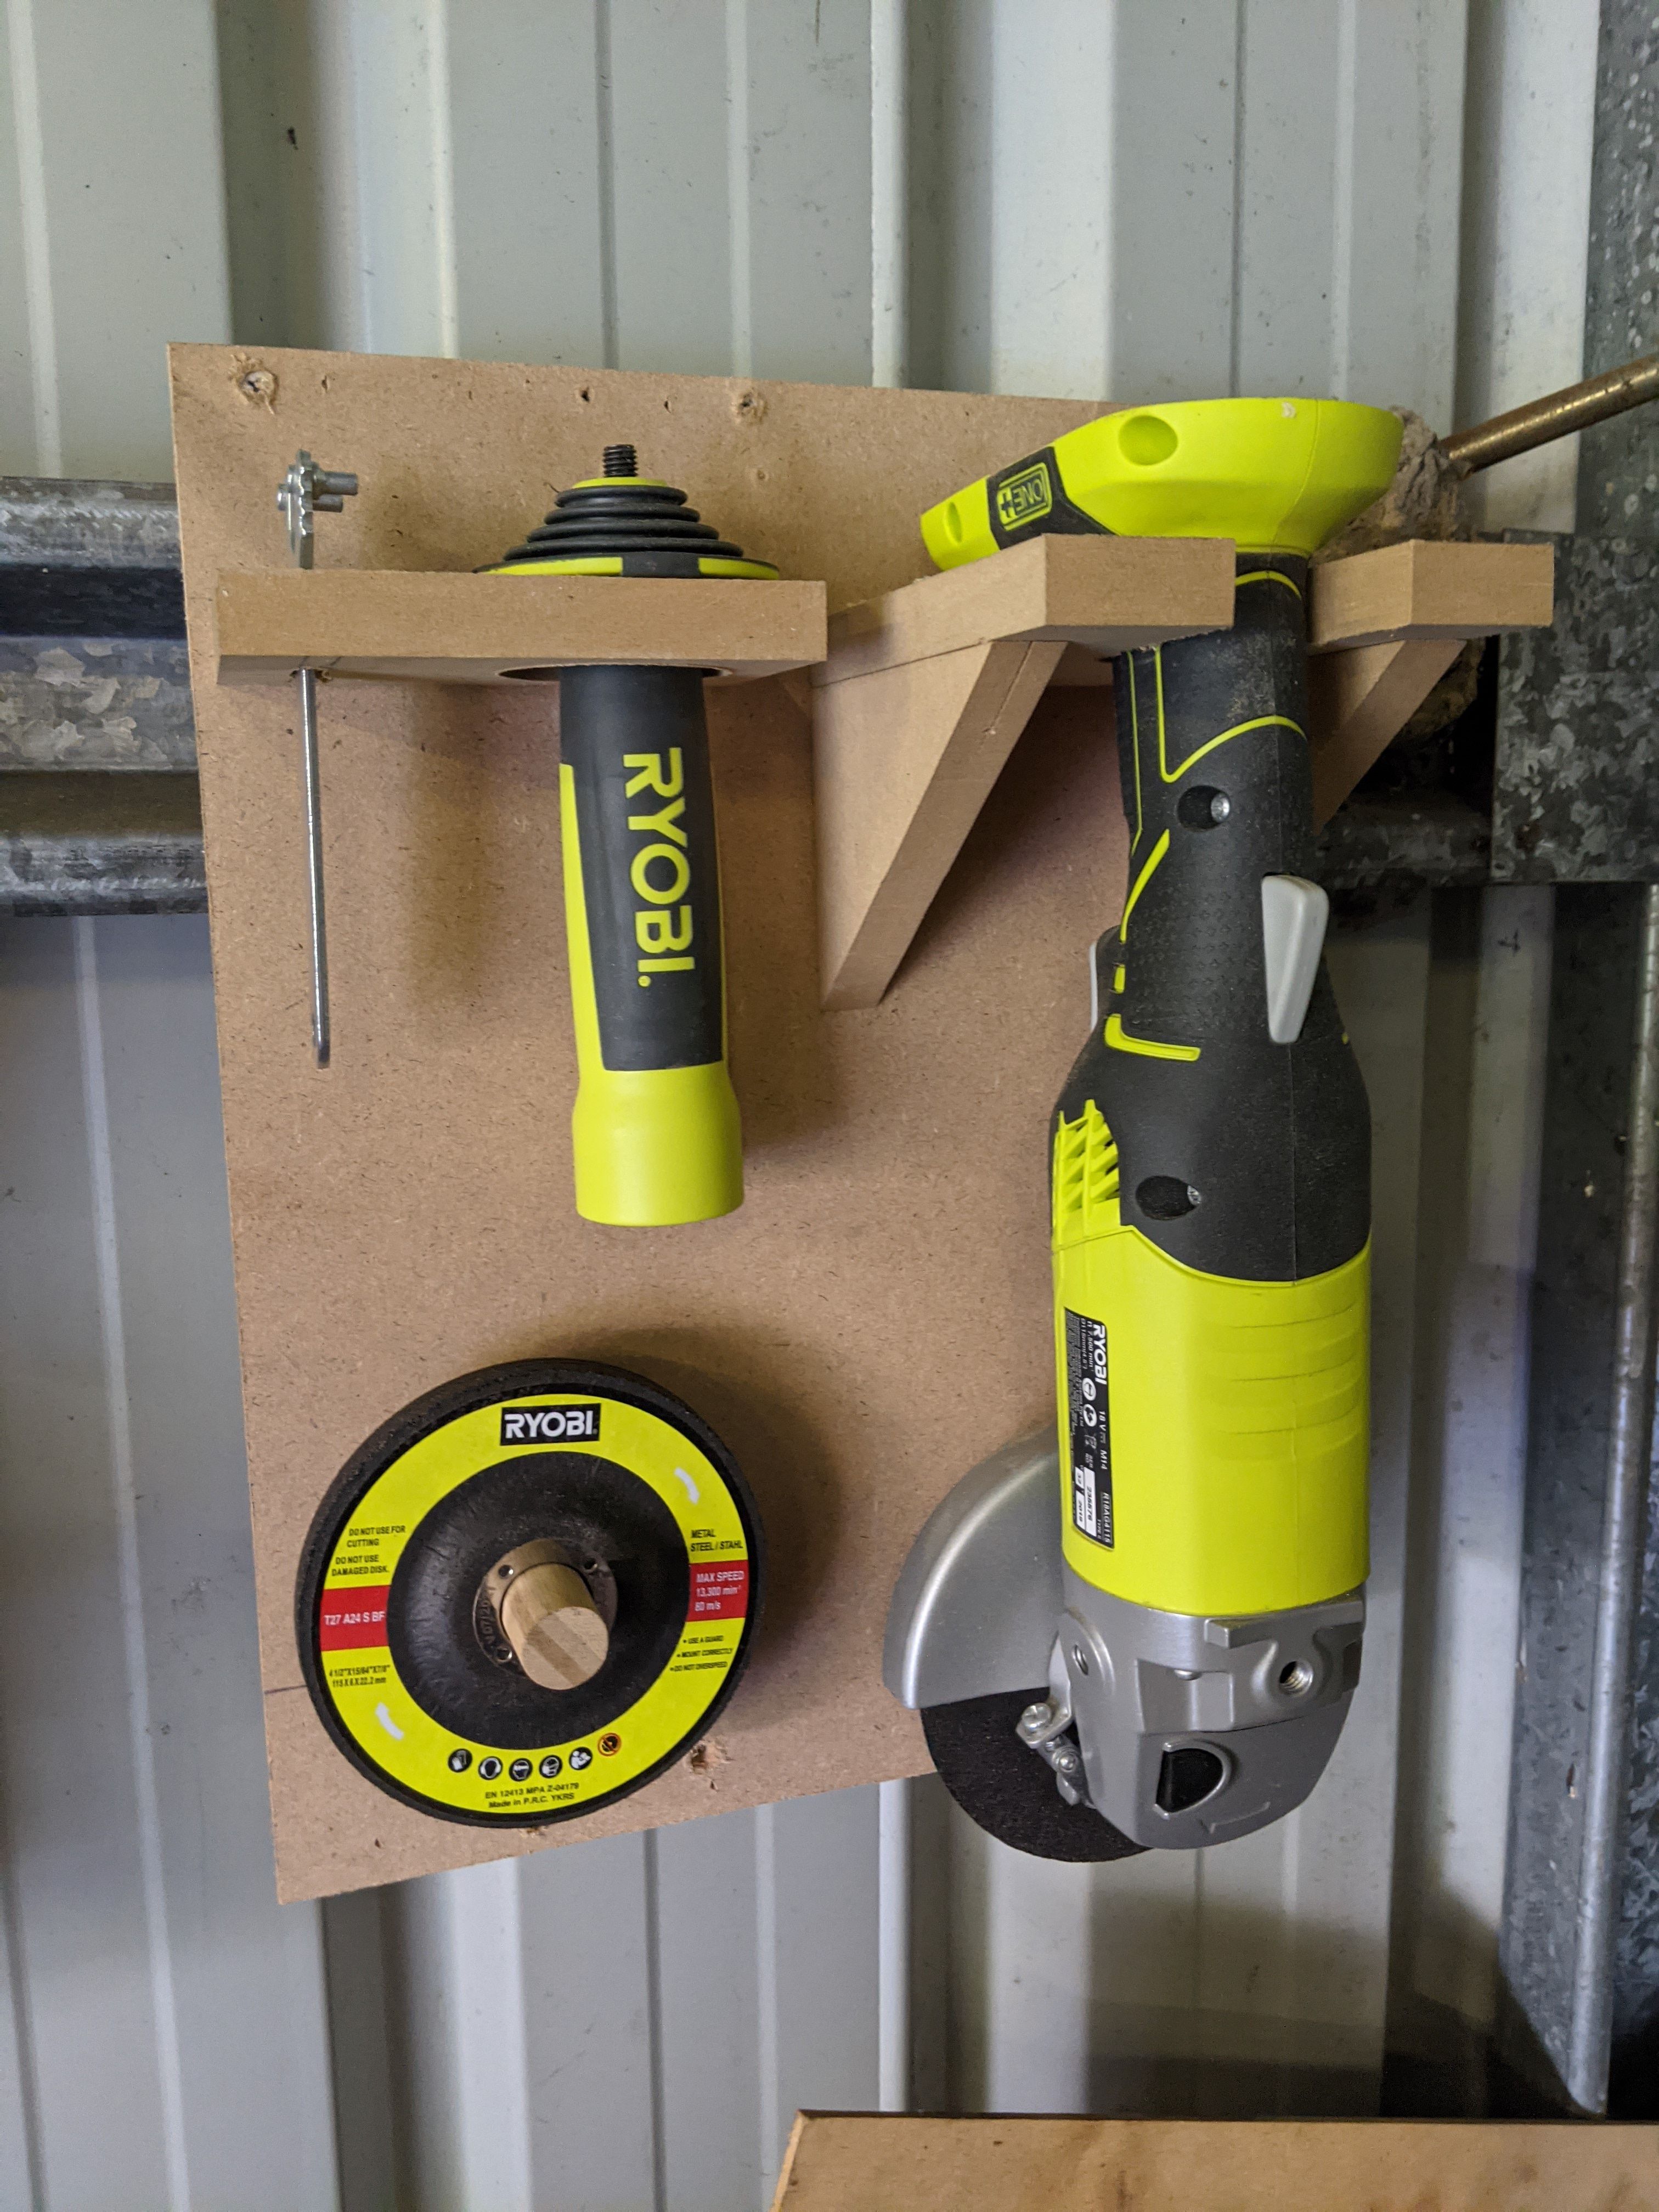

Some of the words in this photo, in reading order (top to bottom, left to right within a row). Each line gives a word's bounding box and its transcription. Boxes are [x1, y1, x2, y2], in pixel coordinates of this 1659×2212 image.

[1092, 1323, 1107, 1385] RYOBI
[1100, 1449, 1108, 1470] M14
[376, 1526, 390, 1534] USE
[391, 1525, 405, 1533] FOR
[691, 1529, 715, 1538] METAL
[347, 1538, 379, 1547] CUTTING
[691, 1542, 714, 1551] STEEL
[720, 1540, 743, 1549] STAHL
[364, 1554, 379, 1562] USE
[332, 1566, 369, 1576] DAMAGED
[696, 1573, 715, 1583] MAX
[716, 1571, 744, 1582] SPEED
[324, 1614, 342, 1626] T27
[342, 1613, 360, 1624] A24
[363, 1612, 370, 1623] S
[371, 1611, 386, 1622] BF
[526, 1786, 545, 1795] MPA
